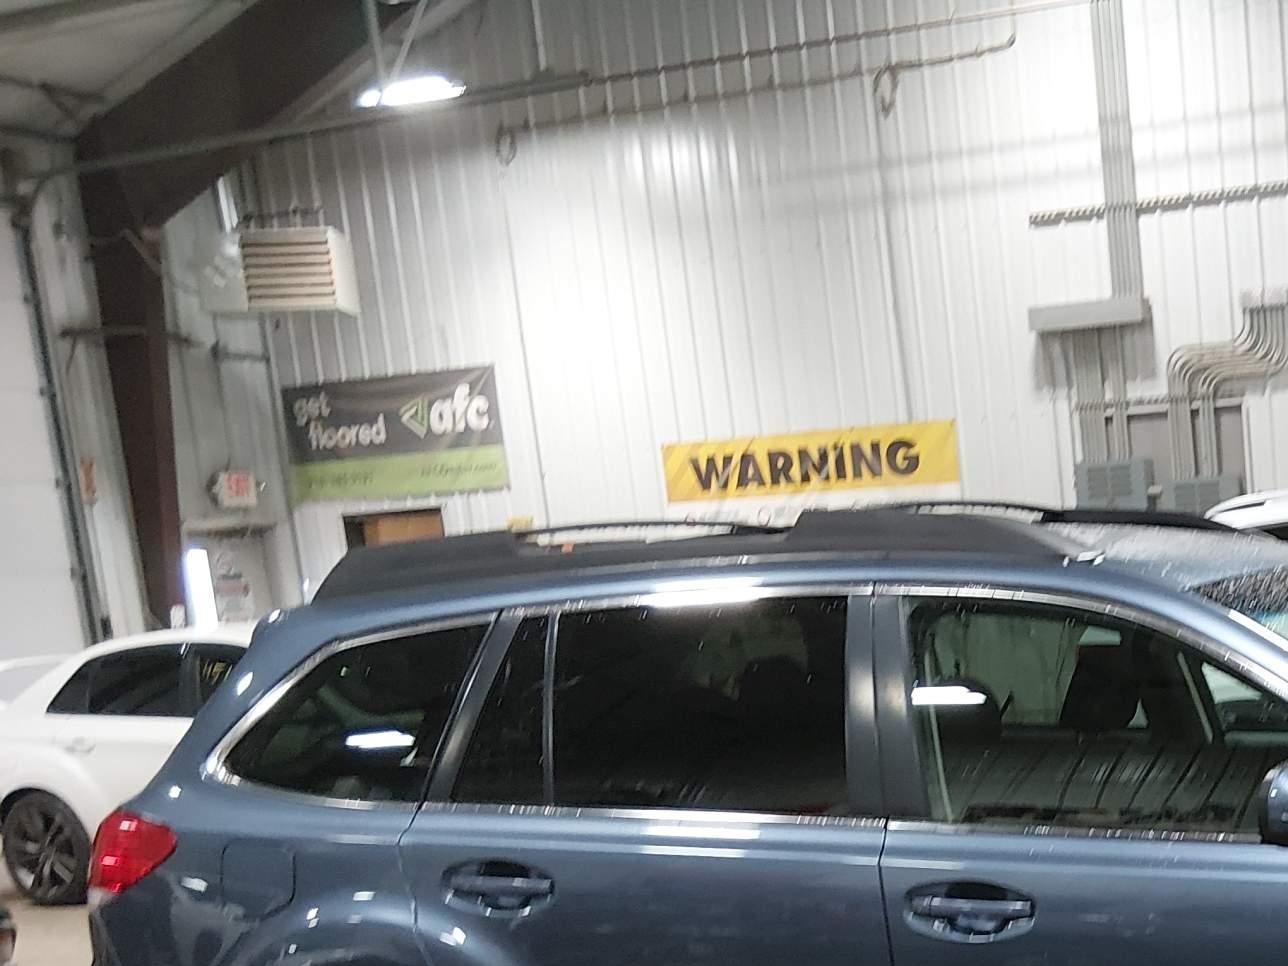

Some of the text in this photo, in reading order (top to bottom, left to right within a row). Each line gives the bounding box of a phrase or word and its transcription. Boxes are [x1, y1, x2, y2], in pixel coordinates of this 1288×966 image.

[293, 391, 331, 427] get
[429, 383, 490, 435] afc
[308, 413, 387, 450] floored
[690, 440, 920, 492] WARNING
